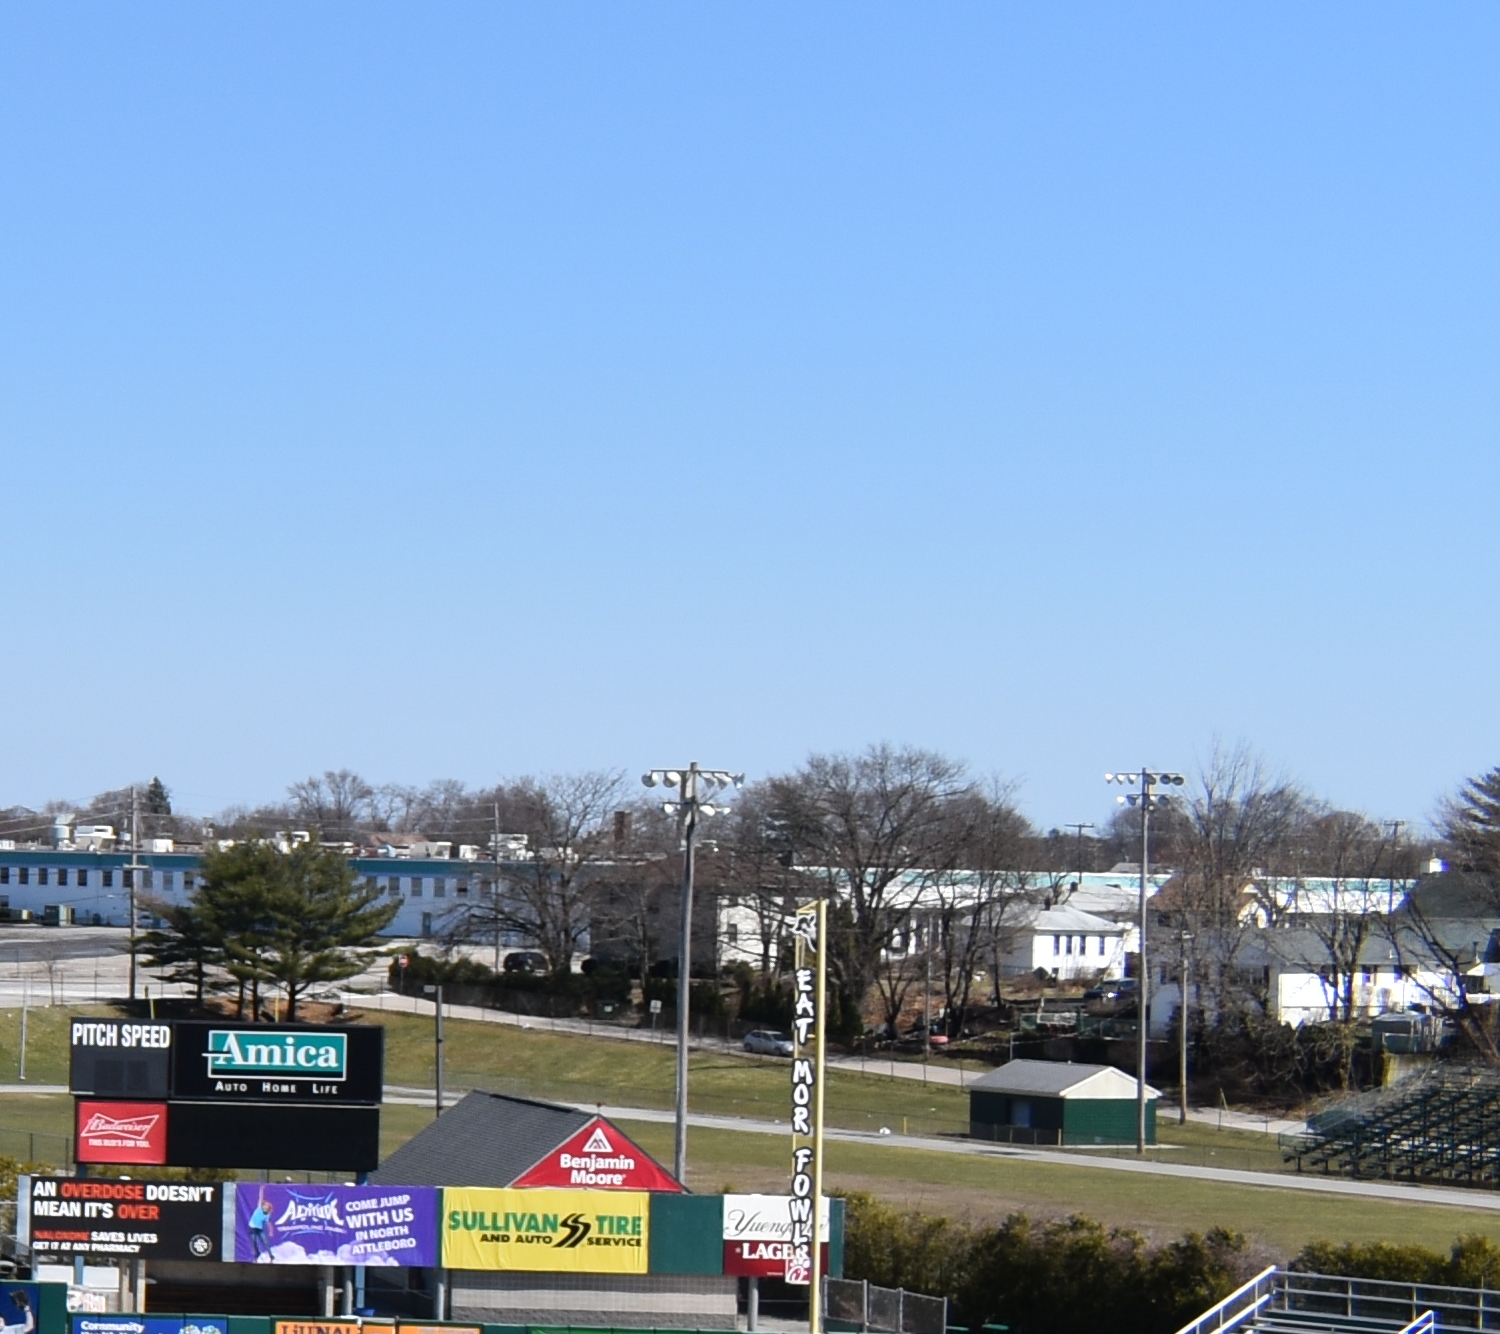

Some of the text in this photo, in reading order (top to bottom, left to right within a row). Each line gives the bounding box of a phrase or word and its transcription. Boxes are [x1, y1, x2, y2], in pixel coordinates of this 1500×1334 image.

[72, 1023, 170, 1048] PITCH SPEED
[212, 1031, 338, 1068] Amica
[560, 1154, 635, 1171] Benjamin
[571, 1170, 622, 1185] Moore
[33, 1181, 214, 1202] AN OVERDOSE DOESN'T
[34, 1201, 160, 1220] MEAN IT'S OVER
[346, 1194, 411, 1211] COME JUMP
[346, 1208, 414, 1229] WITH US
[448, 1210, 643, 1235] SULLIVAN TIRE
[355, 1225, 409, 1241] IN NORTH
[480, 1234, 642, 1247] AND AUTO SERVICE
[352, 1238, 416, 1255] ATTLEBORO
[81, 1321, 145, 1333] Community
